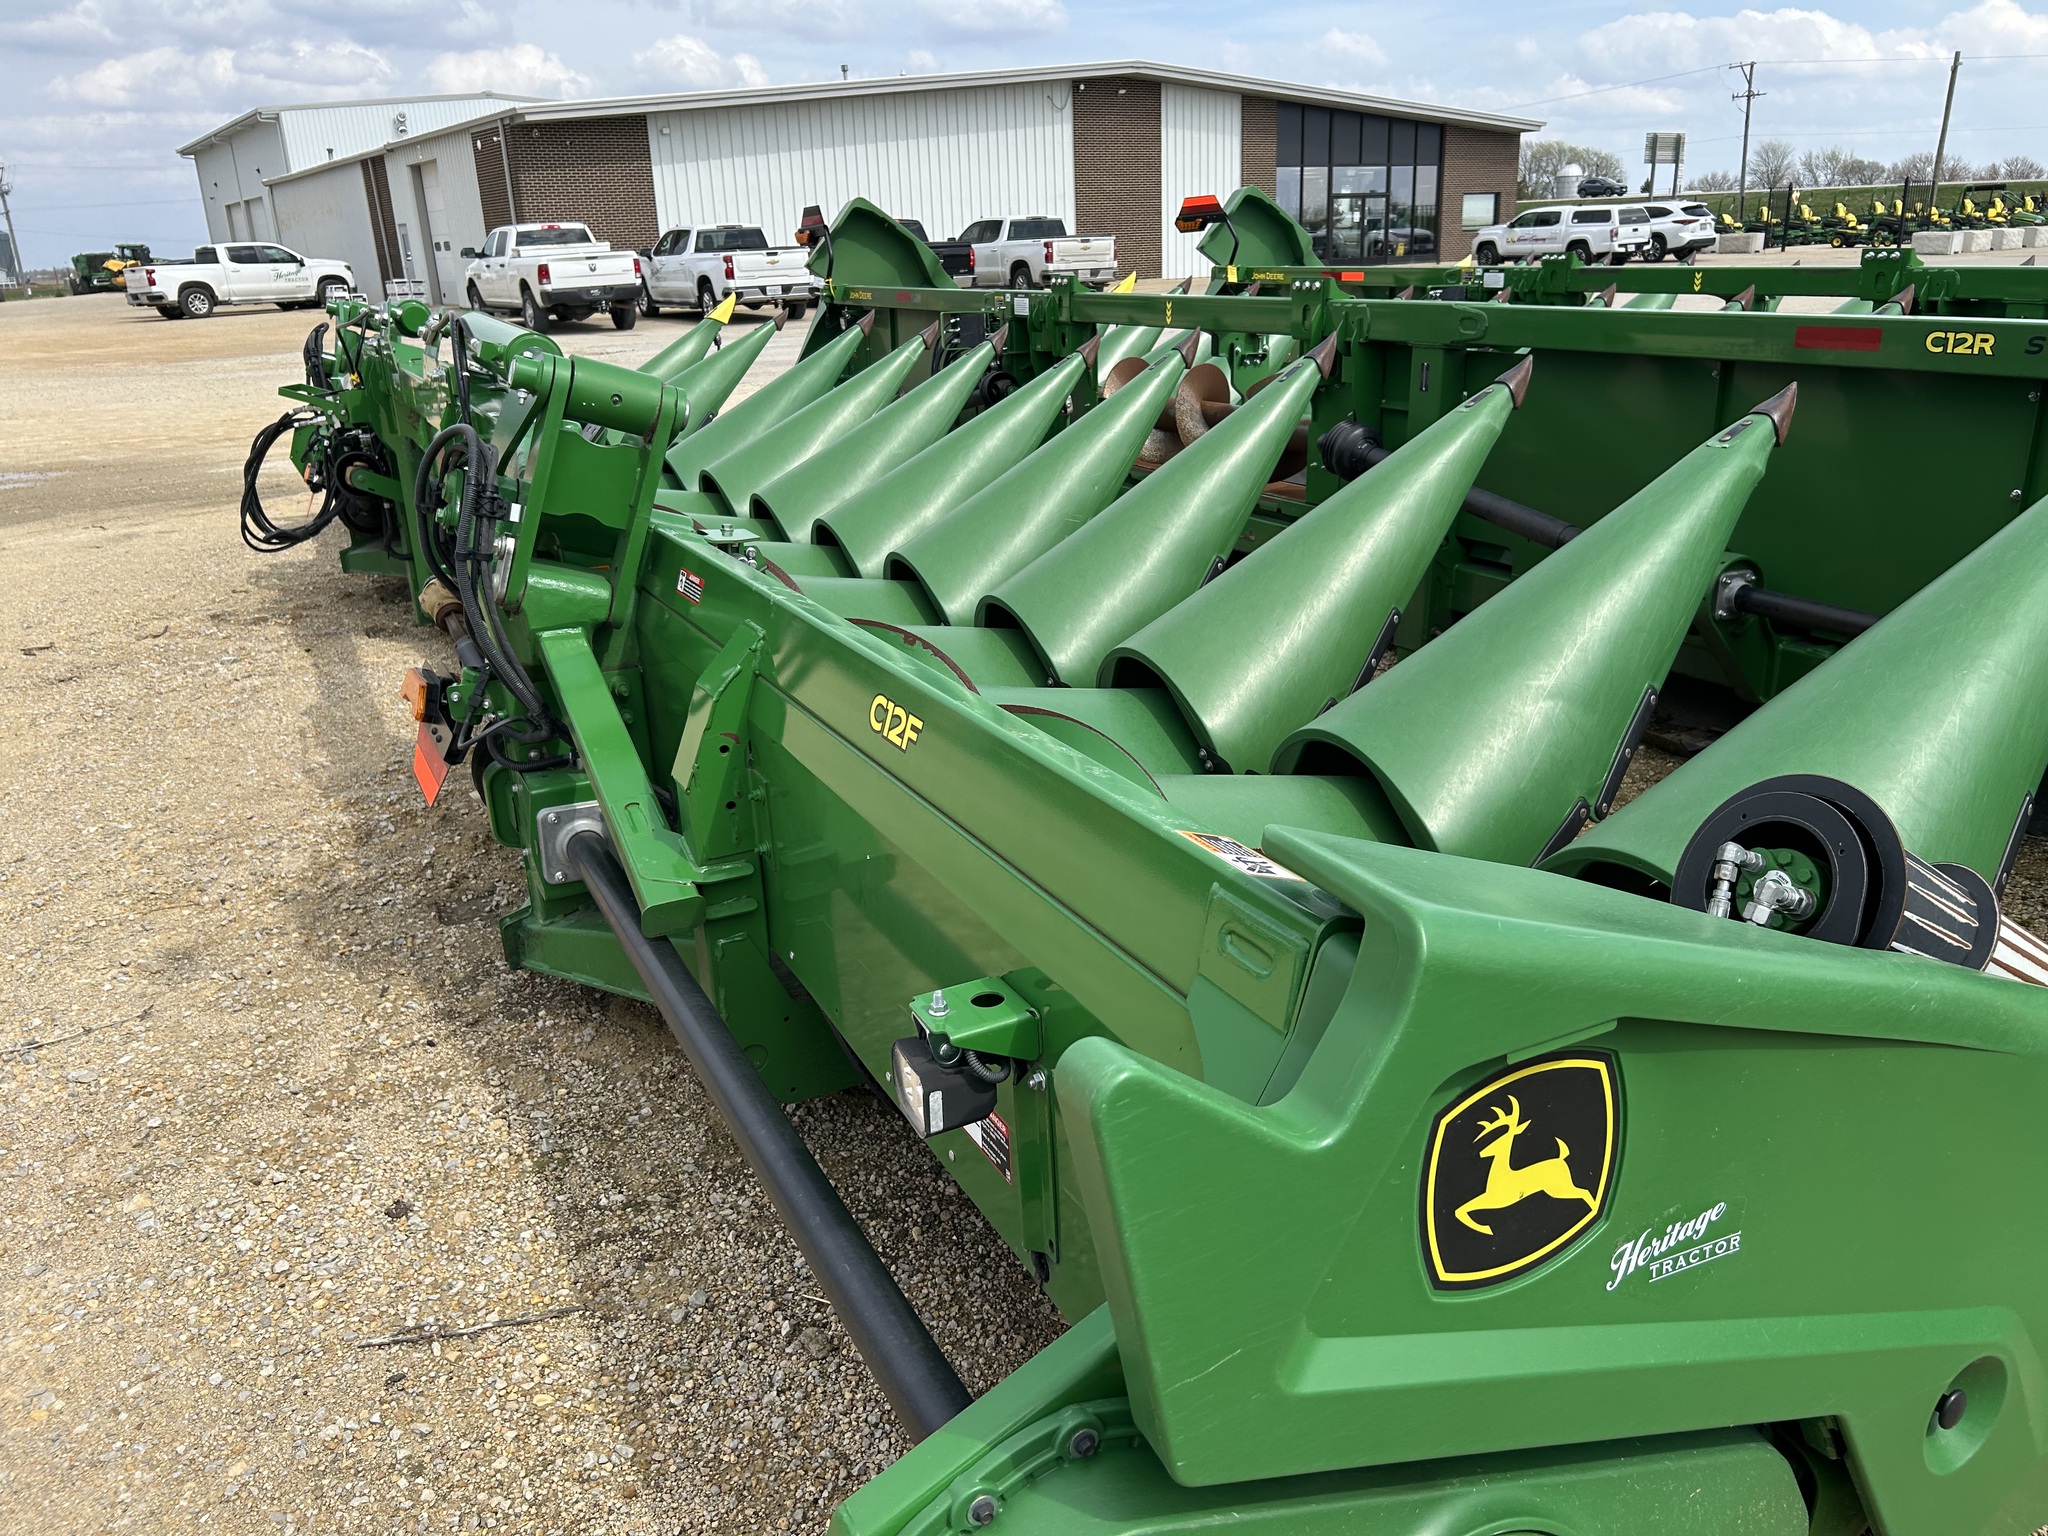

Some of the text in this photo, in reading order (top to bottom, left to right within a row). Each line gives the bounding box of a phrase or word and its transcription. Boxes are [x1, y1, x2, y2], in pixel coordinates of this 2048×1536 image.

[1252, 272, 1285, 280] JOHN DEERE
[1925, 330, 1995, 356] C12R
[869, 693, 925, 753] C12F
[1605, 1201, 1727, 1291] Heritage
[1649, 1235, 1741, 1279] TRACTOR
